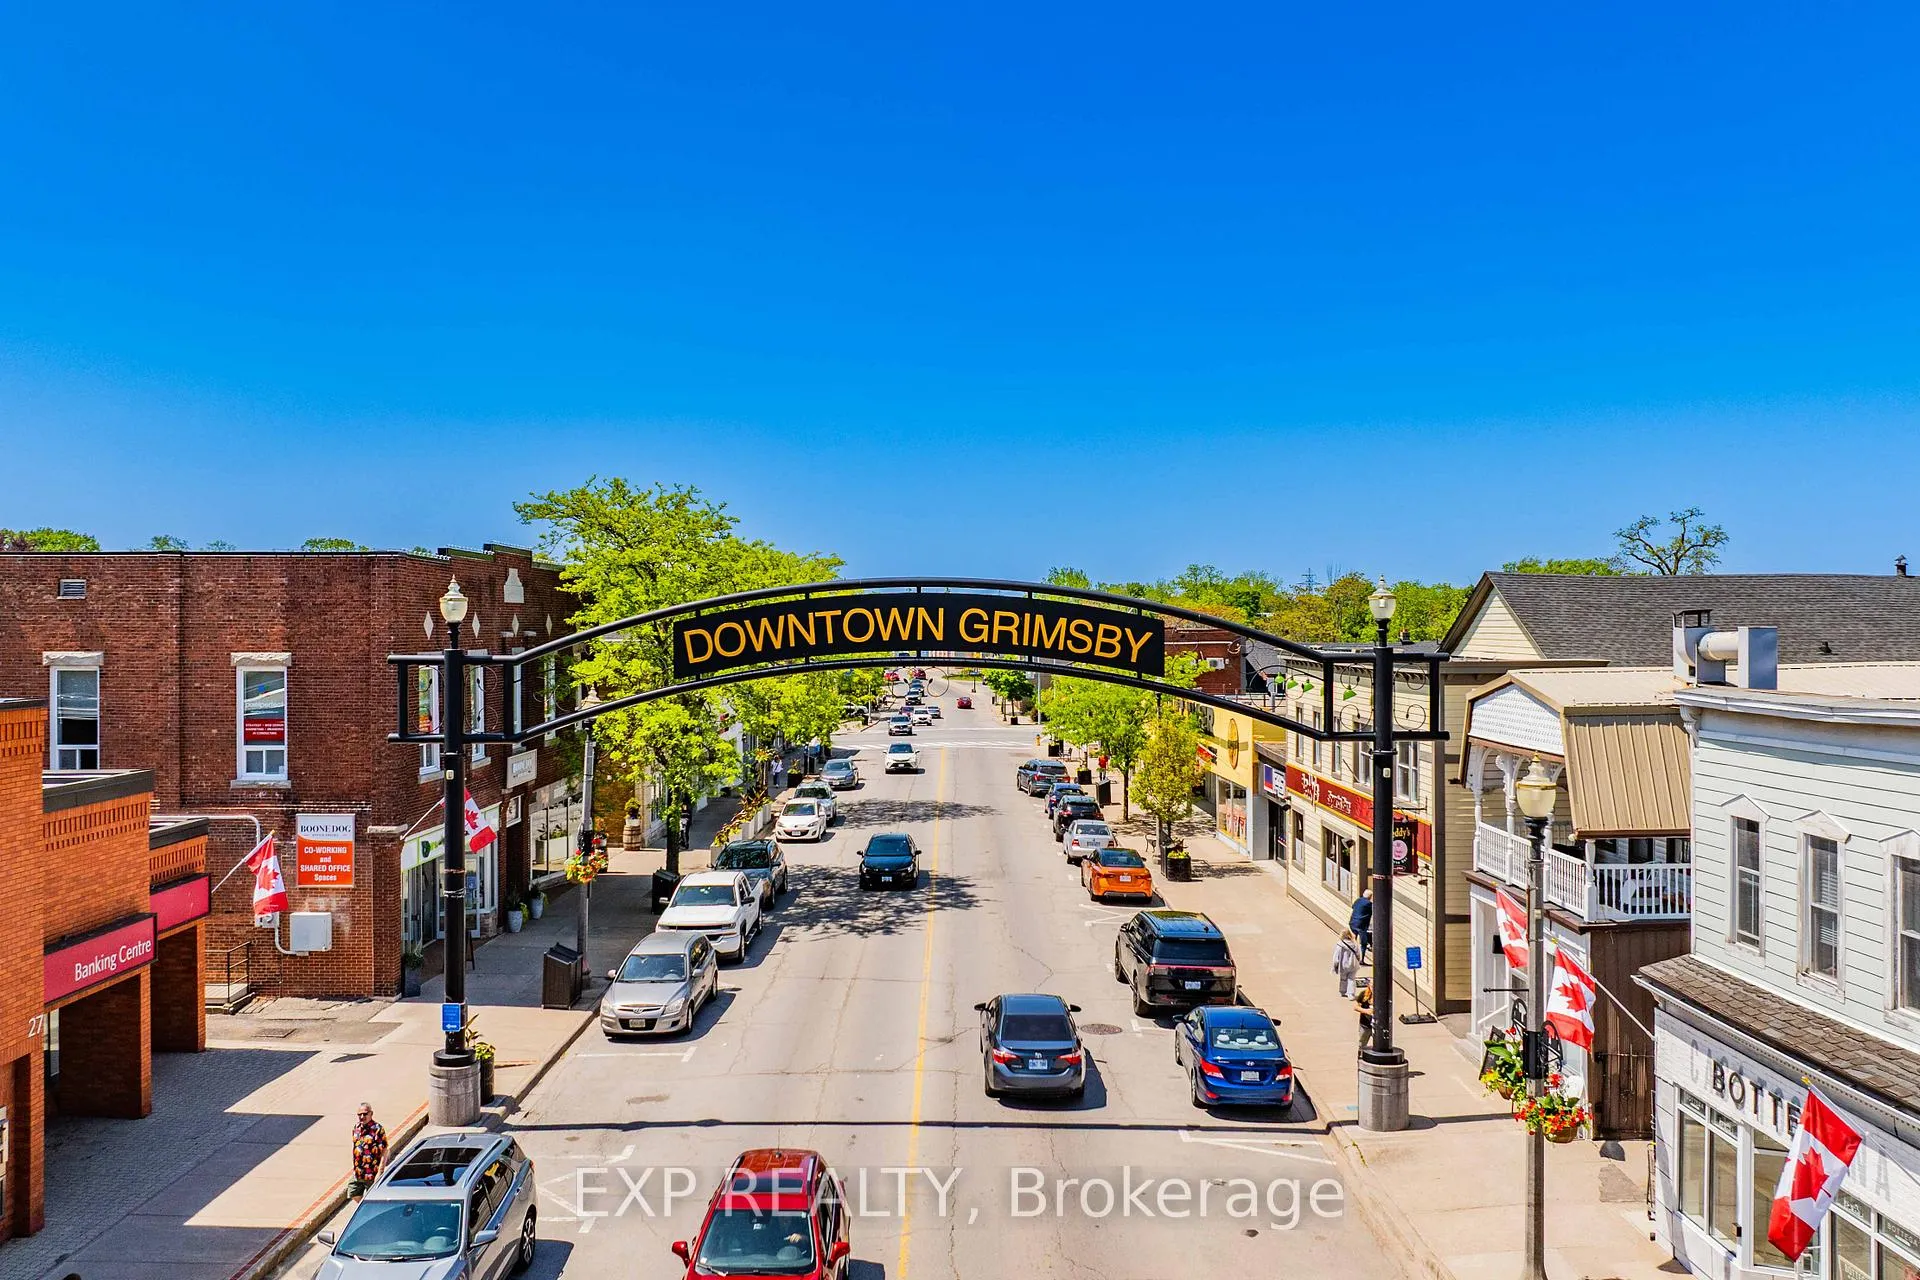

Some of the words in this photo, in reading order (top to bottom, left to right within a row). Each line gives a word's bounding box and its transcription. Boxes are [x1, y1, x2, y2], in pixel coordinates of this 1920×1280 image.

[683, 607, 944, 664] DOWNTOWN
[958, 607, 1154, 663] GRIMSBY
[300, 825, 332, 833] BOONE
[332, 825, 352, 833] DOG
[303, 846, 347, 854] CO-WORKING
[319, 855, 332, 863] and
[300, 864, 327, 872] SHARED
[328, 864, 351, 872] OFFICE
[314, 873, 337, 882] Spaces
[74, 953, 118, 982] Banking
[118, 939, 152, 963] Centre
[28, 1014, 44, 1038] 27
